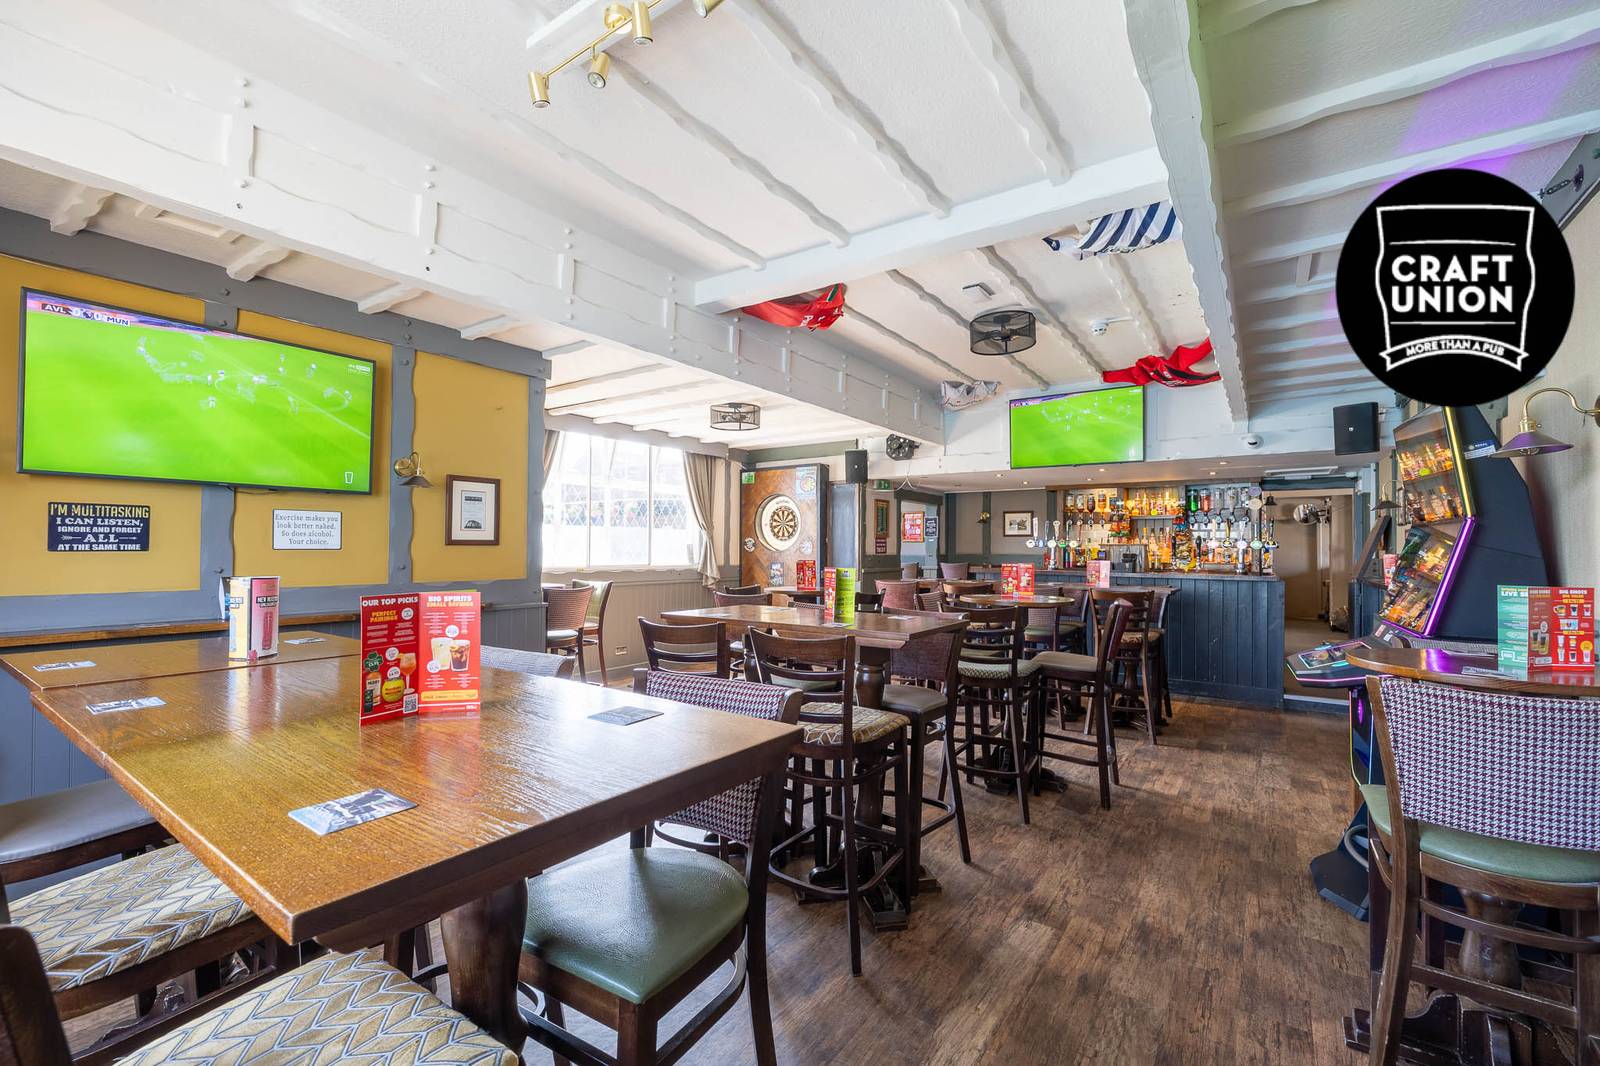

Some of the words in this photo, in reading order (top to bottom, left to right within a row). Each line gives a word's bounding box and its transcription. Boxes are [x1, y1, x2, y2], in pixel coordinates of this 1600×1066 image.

[45, 304, 66, 313] AVL
[106, 316, 129, 326] MUN
[50, 504, 67, 516] I'M
[71, 505, 149, 518] MULTITASKING
[275, 513, 304, 521] Exercise
[96, 518, 143, 527] LISTEN,
[276, 521, 293, 529] look
[293, 522, 314, 530] better
[83, 533, 119, 543] ALL
[291, 530, 307, 538] does
[308, 530, 334, 538] alcohol.
[57, 543, 71, 551] AT
[72, 543, 90, 551] THE
[91, 543, 118, 551] SAME
[119, 543, 141, 551] TIME
[362, 599, 379, 607] OUR
[398, 596, 418, 604] PICKS
